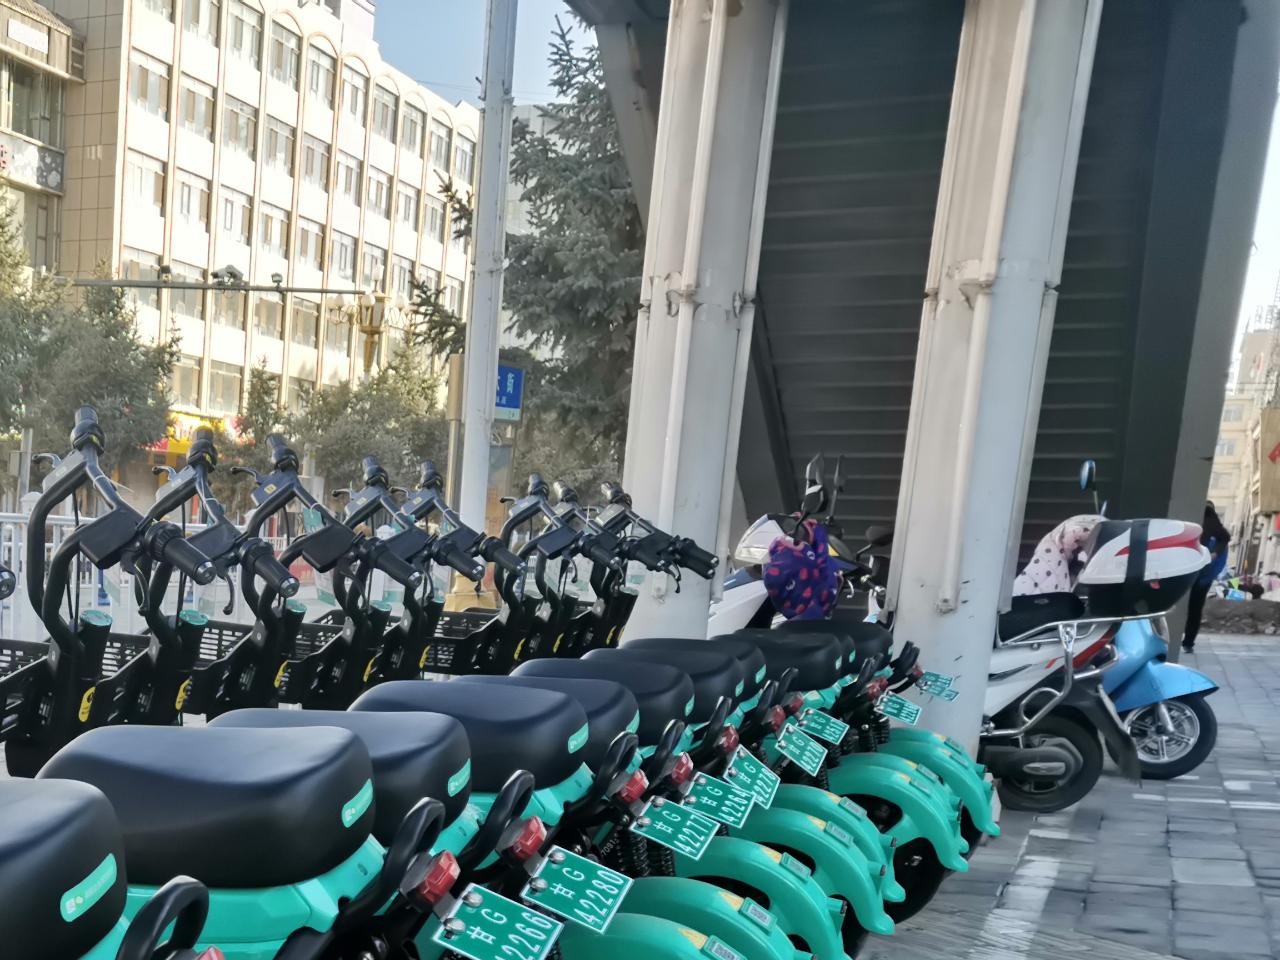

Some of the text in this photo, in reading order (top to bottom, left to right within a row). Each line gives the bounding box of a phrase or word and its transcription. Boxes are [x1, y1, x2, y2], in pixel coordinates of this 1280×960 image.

[719, 788, 752, 823] 42264
[674, 814, 713, 854] 42277
[574, 869, 625, 926] 42280
